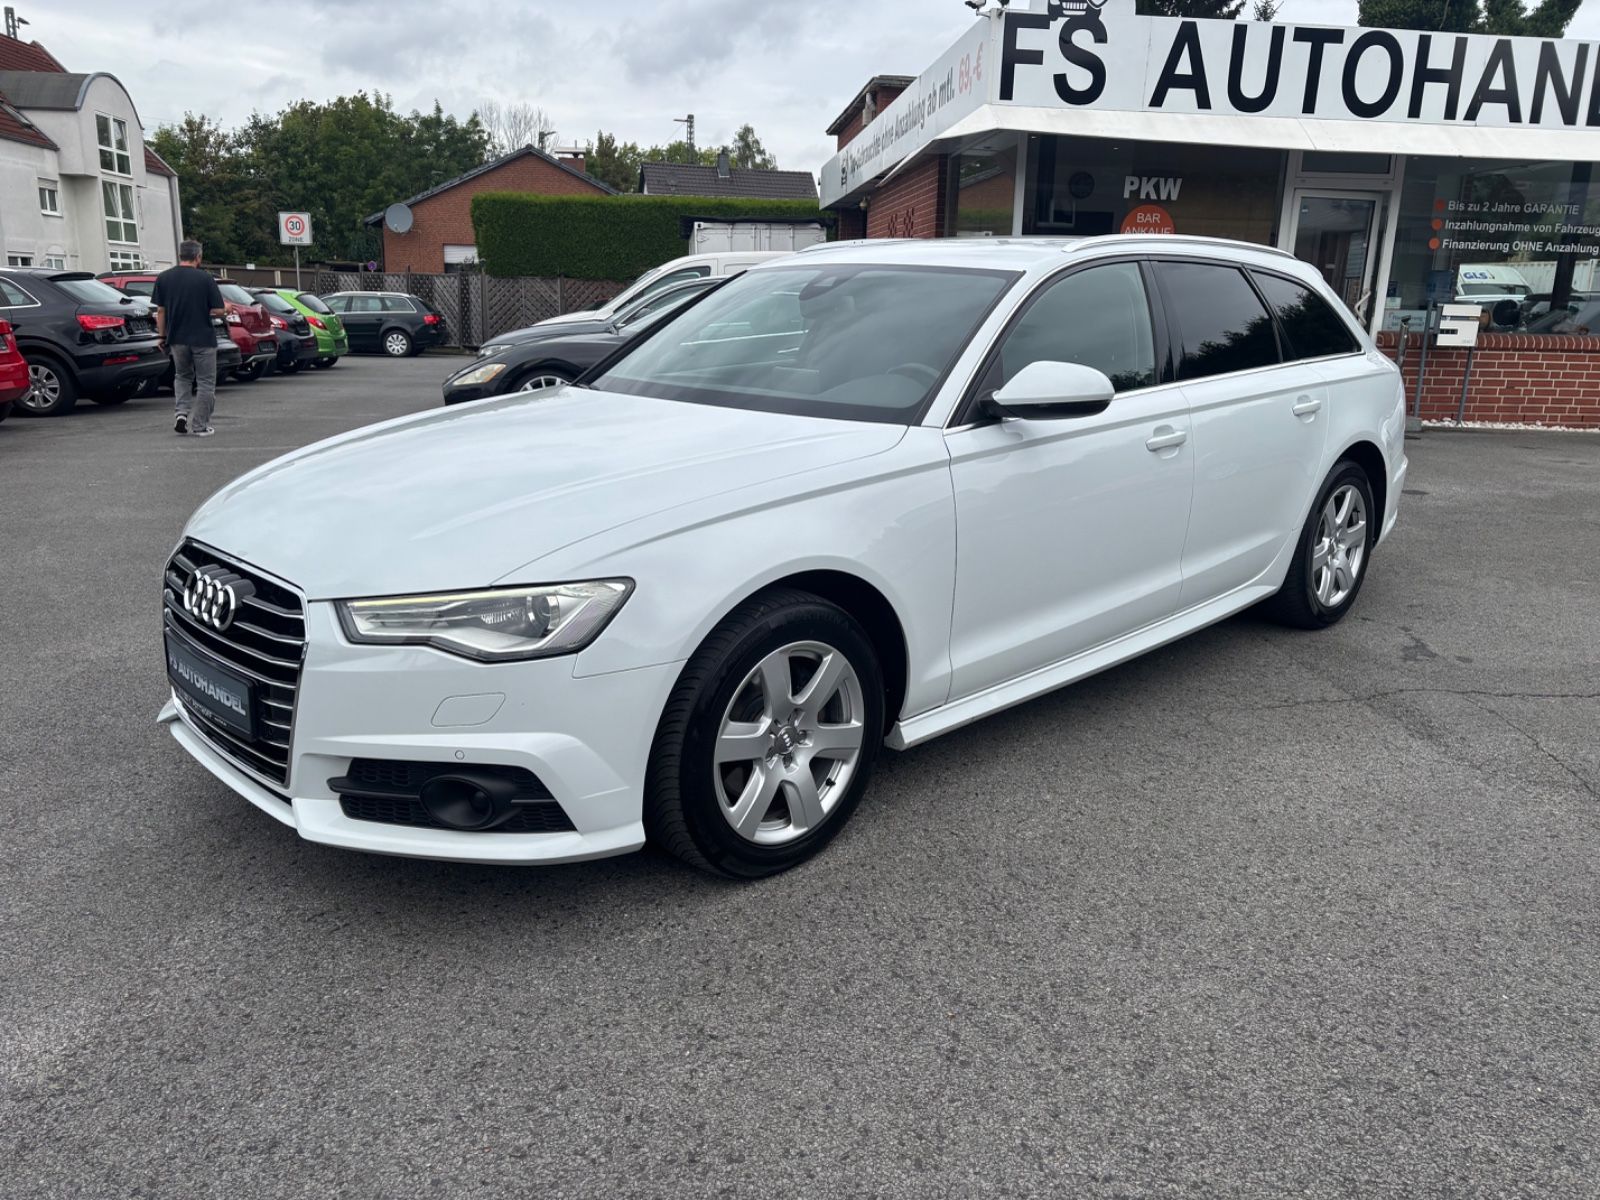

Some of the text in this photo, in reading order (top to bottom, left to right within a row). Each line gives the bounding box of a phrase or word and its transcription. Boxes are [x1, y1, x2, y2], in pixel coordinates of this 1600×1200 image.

[1000, 12, 1600, 127] FS AUTOHAN
[895, 98, 926, 141] Anzahlung
[927, 82, 937, 117] ab
[938, 67, 955, 109] mtl.
[1123, 176, 1183, 201] PKW
[1448, 201, 1580, 215] Bis zu 2 Jahre GARANTIE
[1136, 213, 1161, 223] BAR
[289, 221, 301, 230] 30
[1445, 219, 1530, 233] Inzahlungnahme
[1533, 224, 1552, 233] von
[1442, 239, 1510, 252] Finanzierung
[1512, 241, 1544, 251] OHNE
[1463, 270, 1488, 280] GLS
[178, 661, 247, 716] AUTOHANDEL
